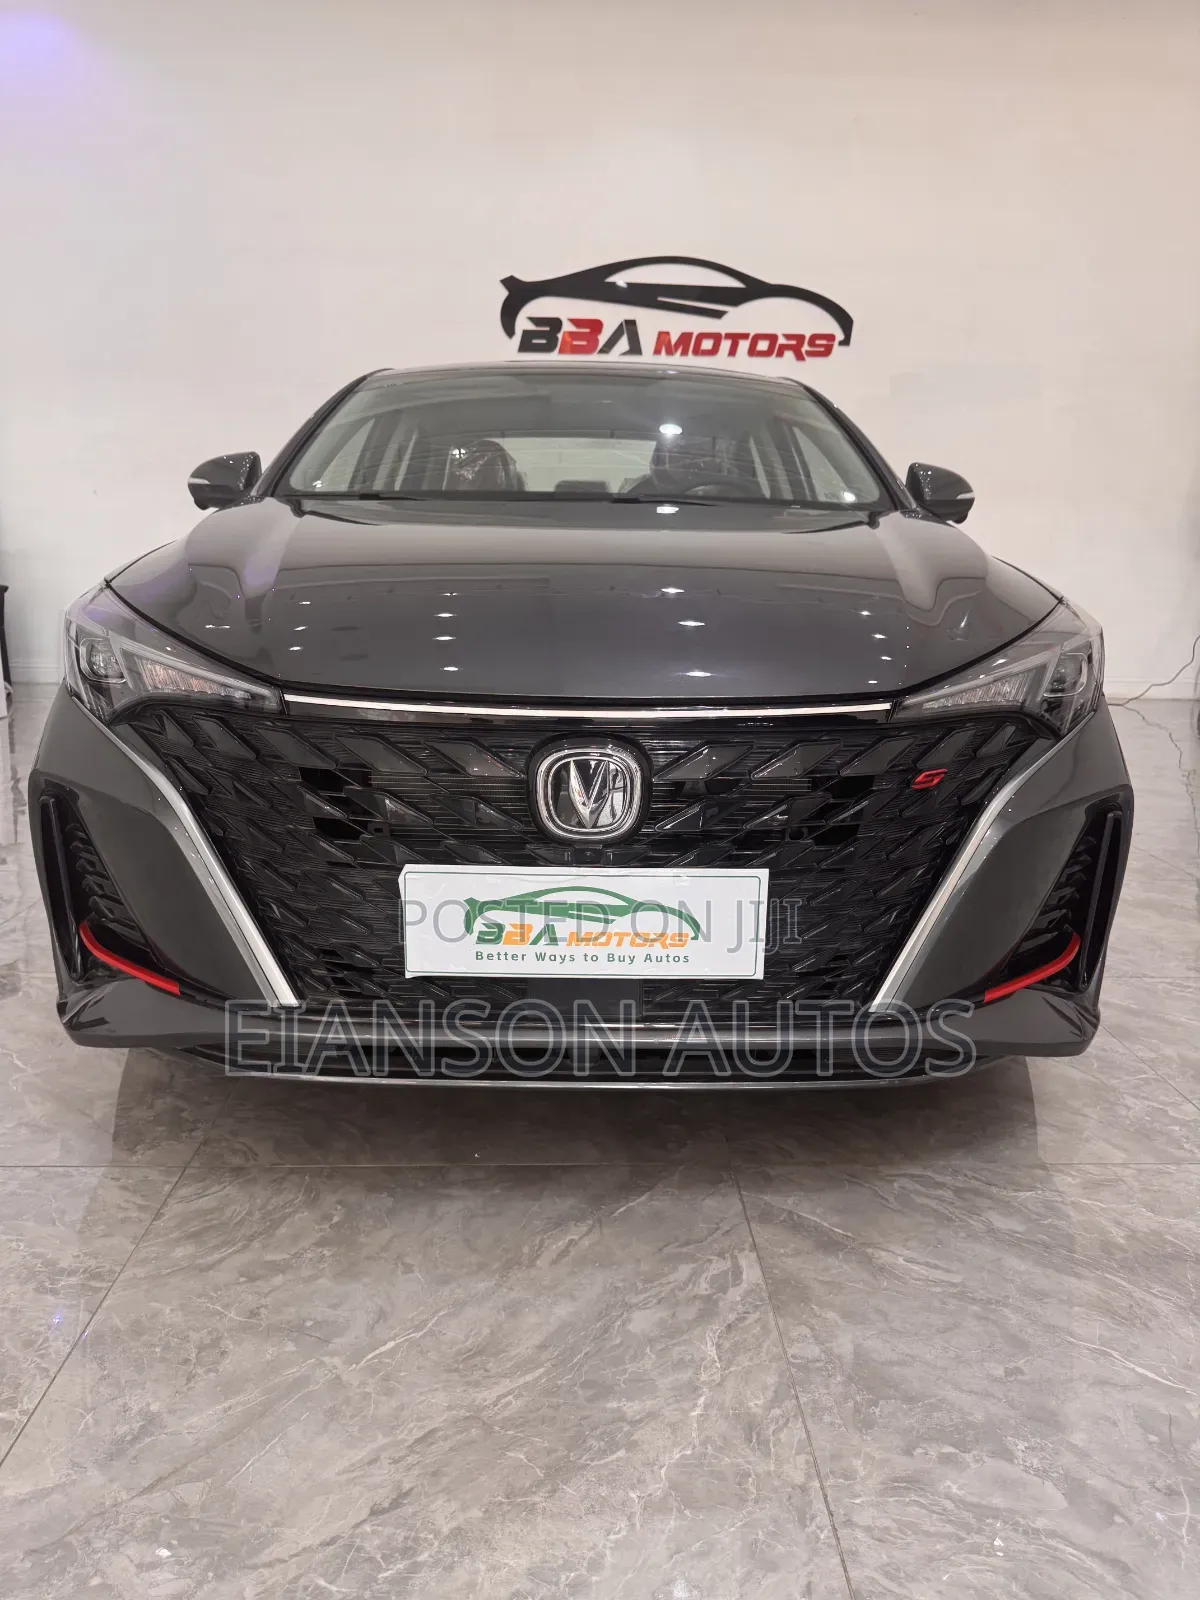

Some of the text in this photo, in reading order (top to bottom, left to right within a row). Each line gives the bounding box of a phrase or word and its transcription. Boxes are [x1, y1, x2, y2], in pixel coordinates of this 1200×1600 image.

[517, 316, 836, 361] BBA MOTORS
[475, 922, 690, 949] BBA MOTORS
[475, 950, 690, 965] Better Ways to Buy Autos
